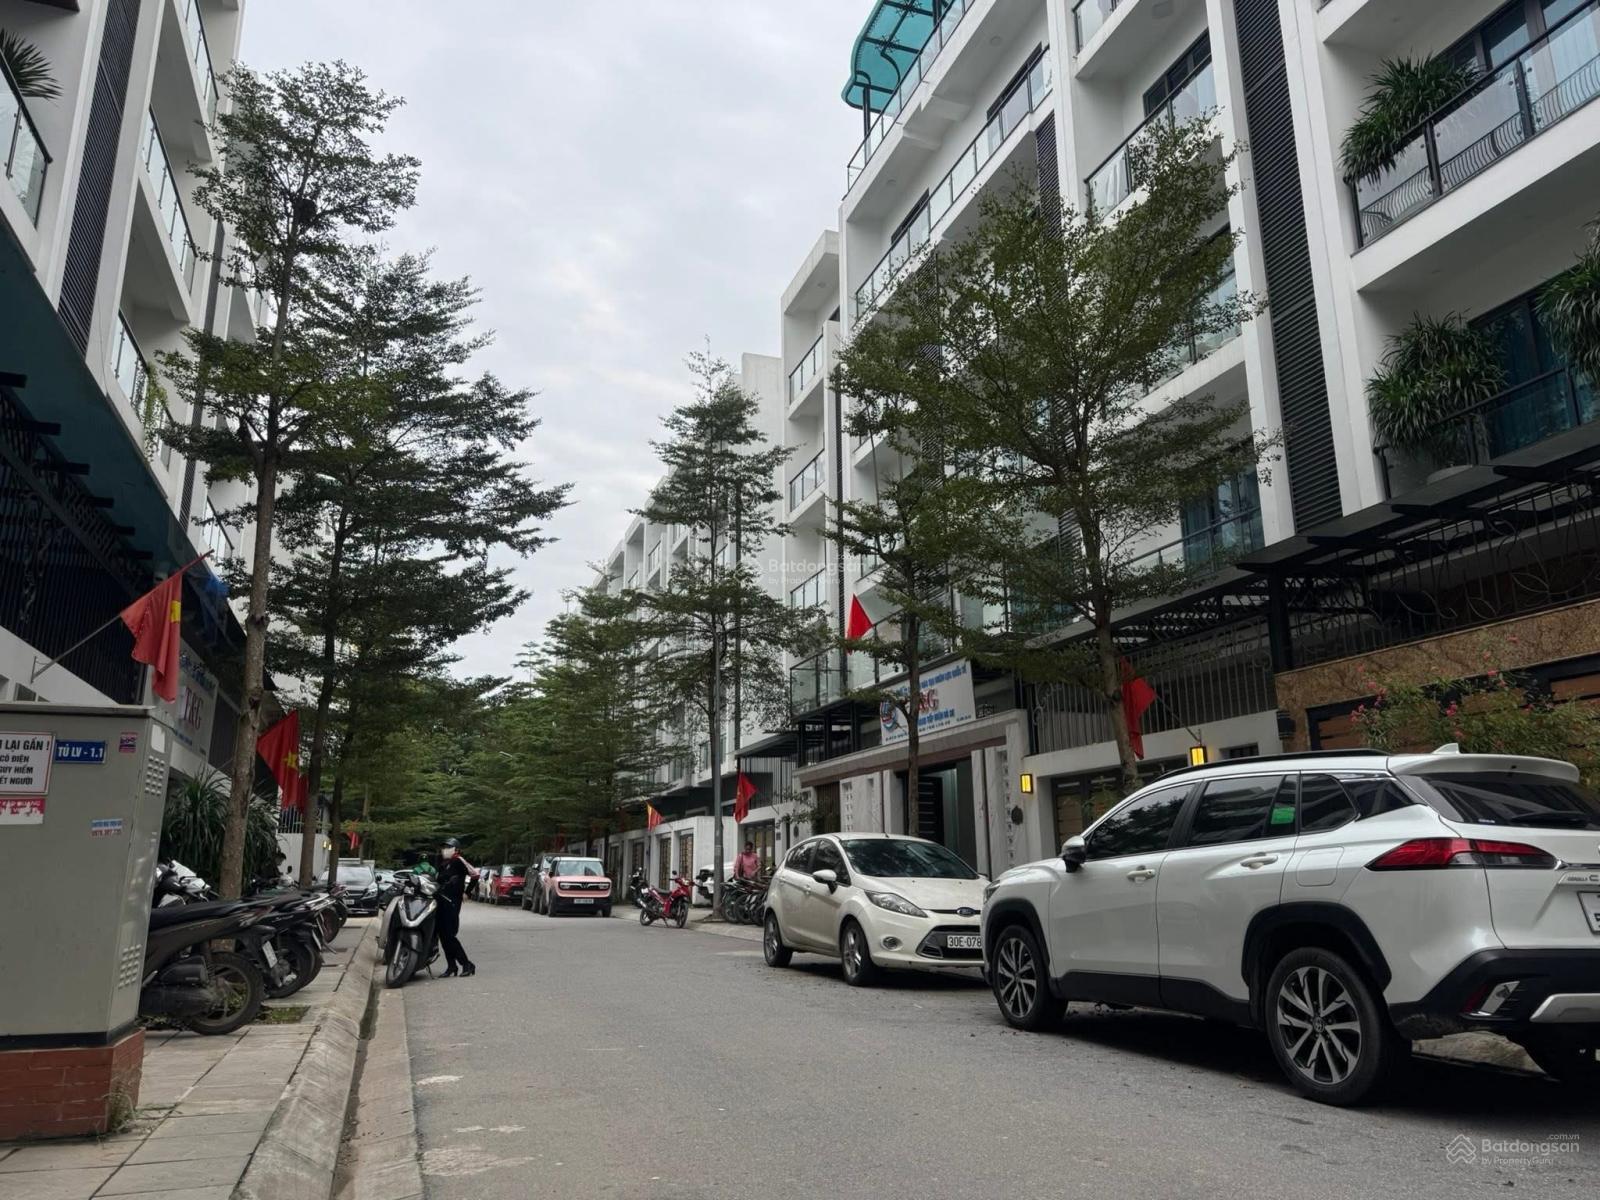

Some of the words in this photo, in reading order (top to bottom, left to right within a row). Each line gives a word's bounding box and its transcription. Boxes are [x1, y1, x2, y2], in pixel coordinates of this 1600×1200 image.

[5, 739, 20, 752] LẠI
[58, 743, 70, 757] TỦ
[71, 746, 82, 757] LV
[91, 747, 103, 758] 1.1
